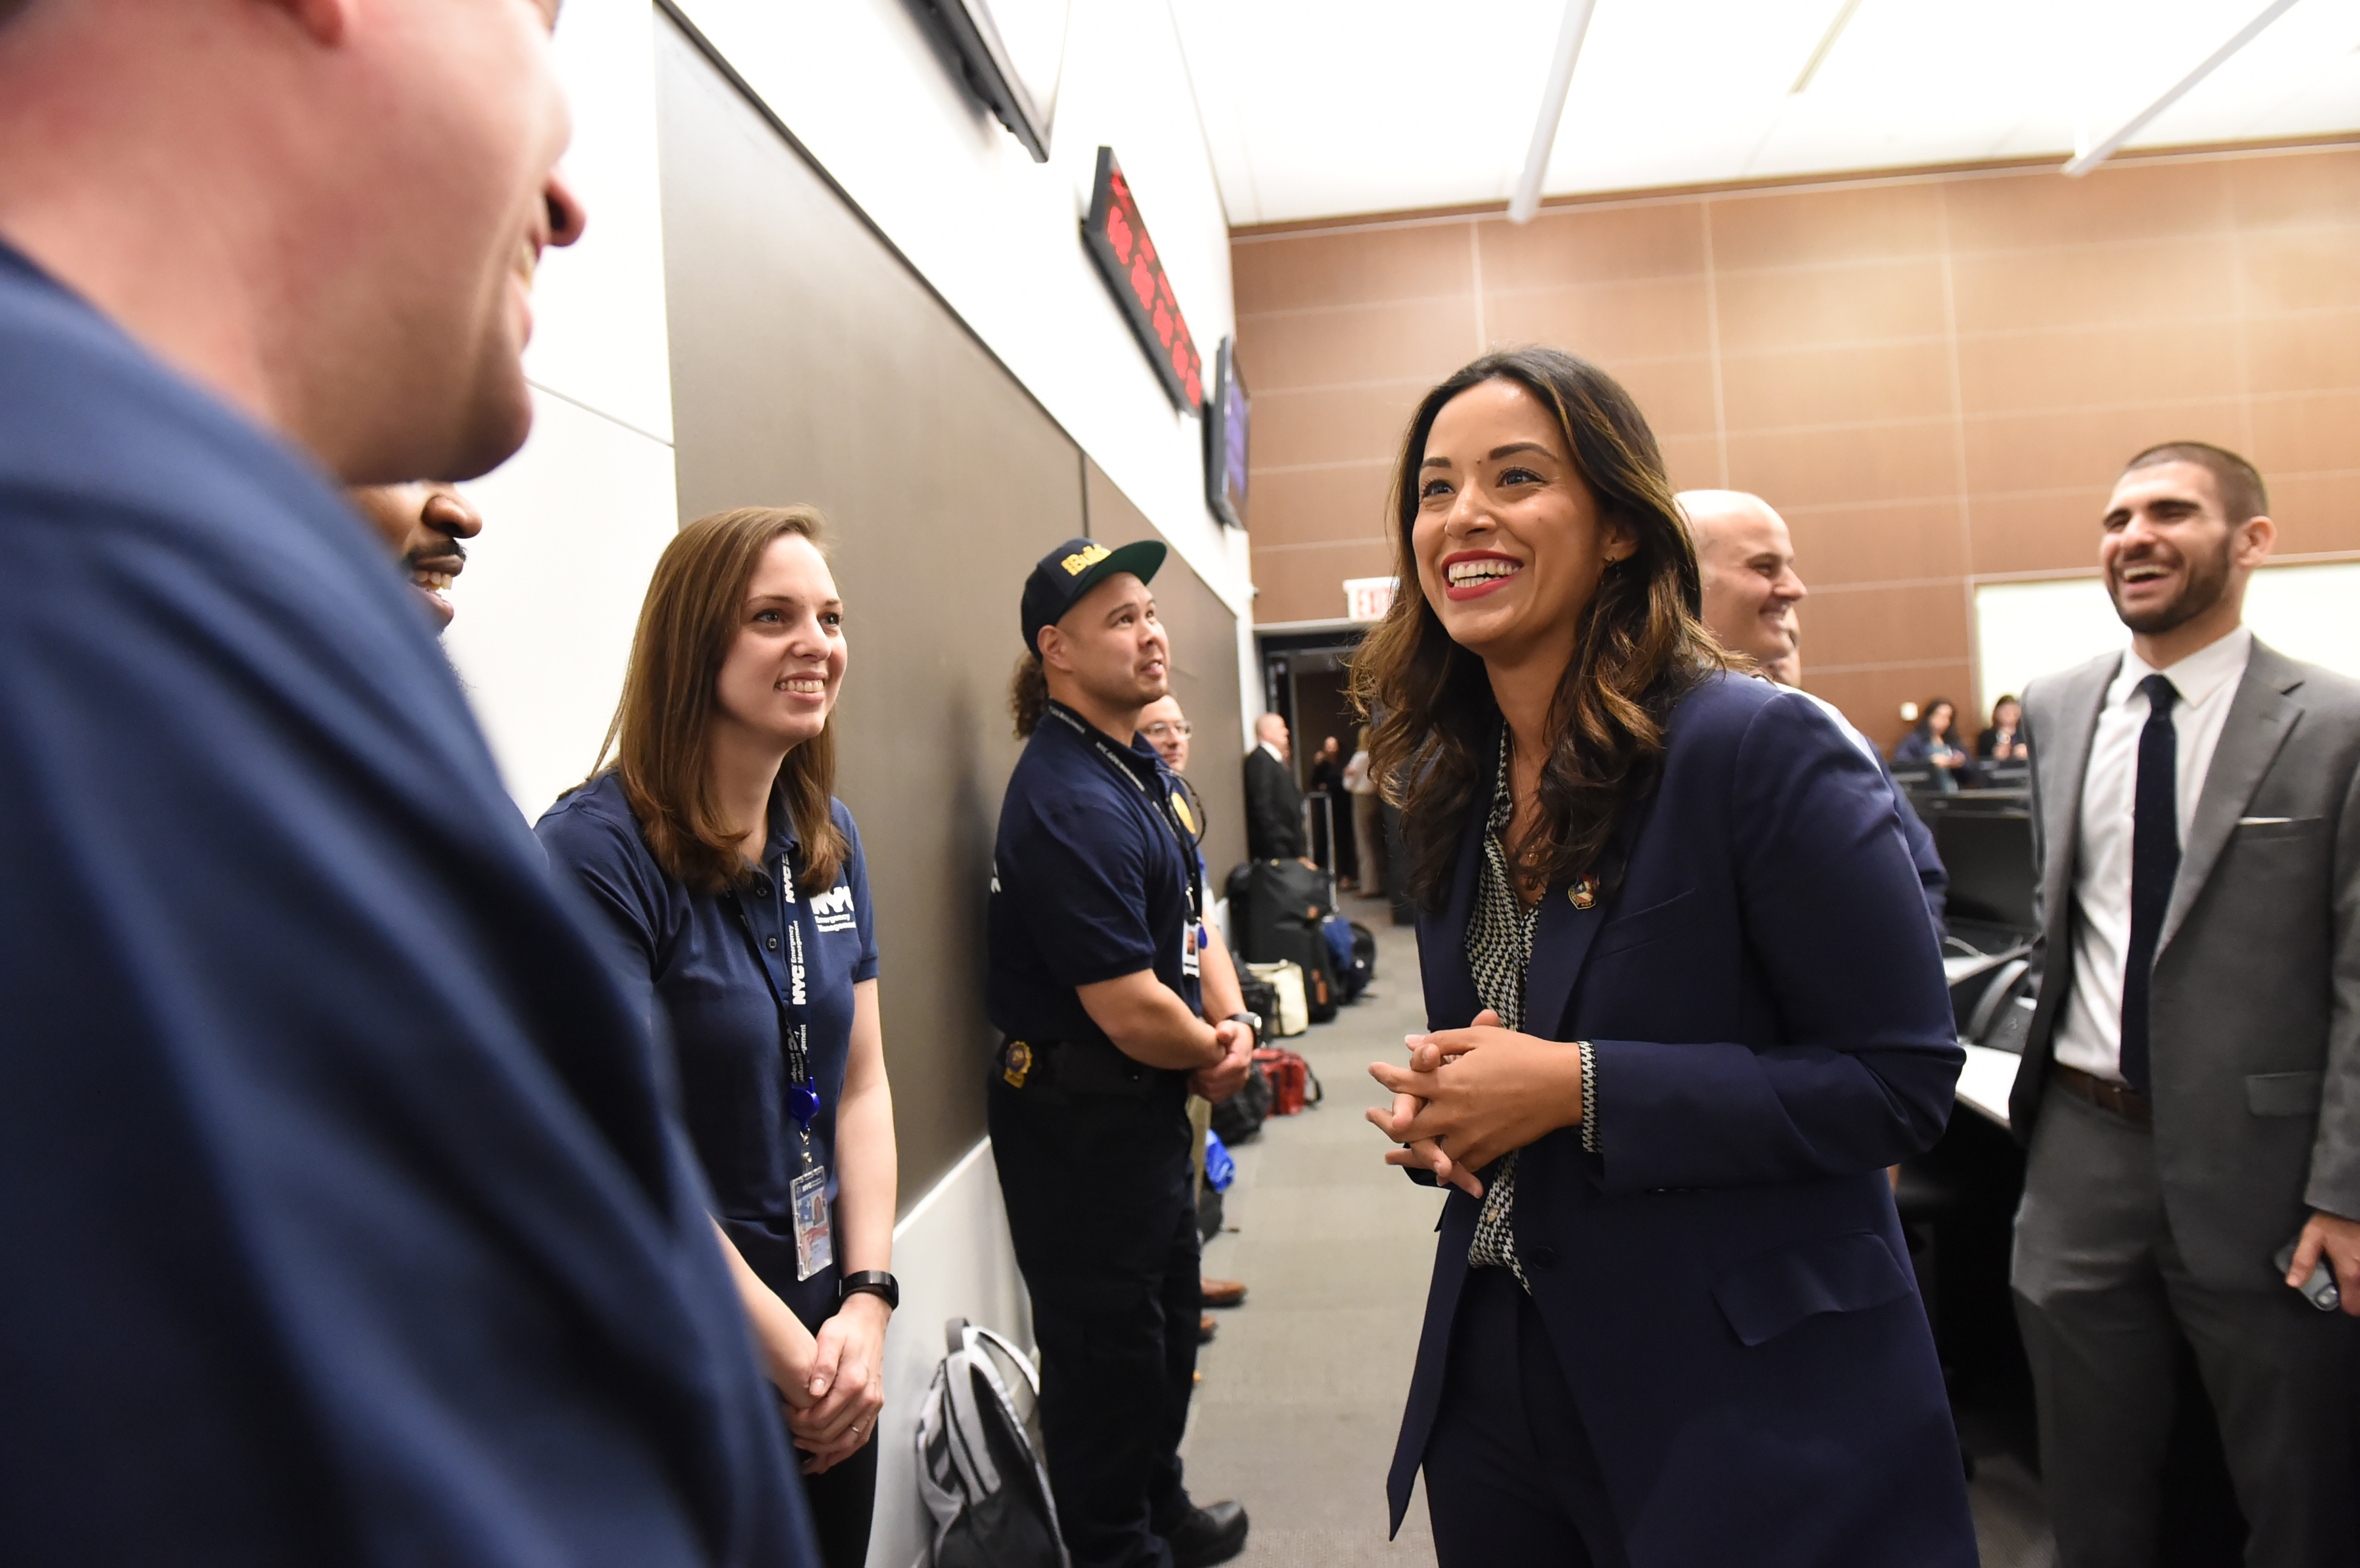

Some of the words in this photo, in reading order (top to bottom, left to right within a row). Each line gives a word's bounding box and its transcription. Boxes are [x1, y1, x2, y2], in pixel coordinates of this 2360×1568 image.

[788, 924, 797, 963] Emergency
[793, 920, 804, 964] Management
[792, 965, 806, 1005] NYC
